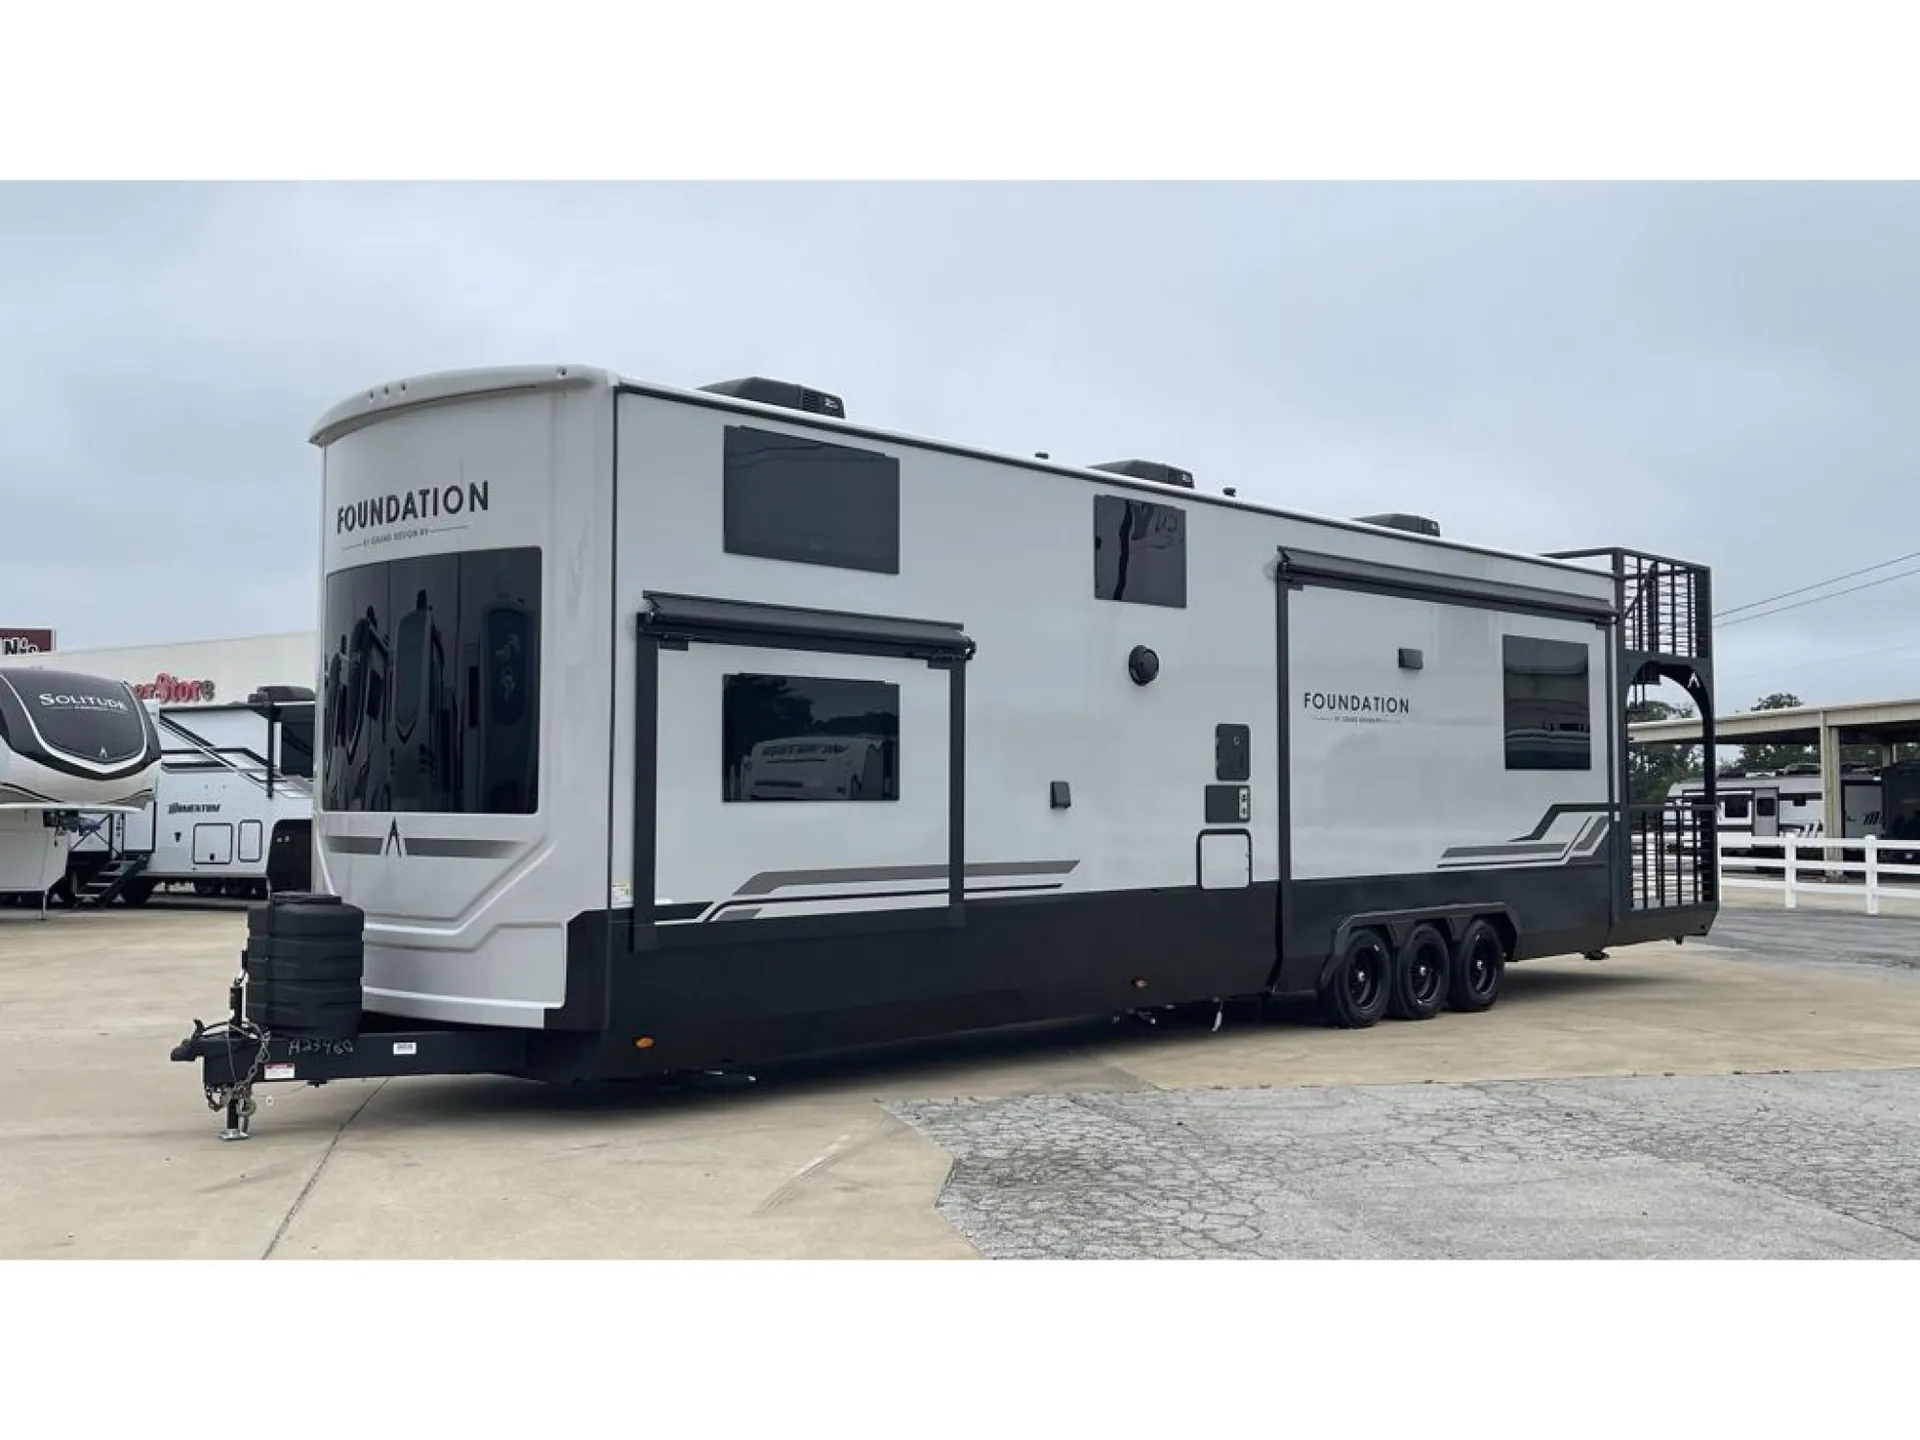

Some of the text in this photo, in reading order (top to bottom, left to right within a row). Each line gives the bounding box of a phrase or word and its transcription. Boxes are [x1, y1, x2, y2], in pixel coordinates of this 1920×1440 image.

[337, 480, 489, 534] FOUNDATION
[39, 693, 128, 711] SOLITUDE
[1304, 692, 1409, 714] FOUNDATION
